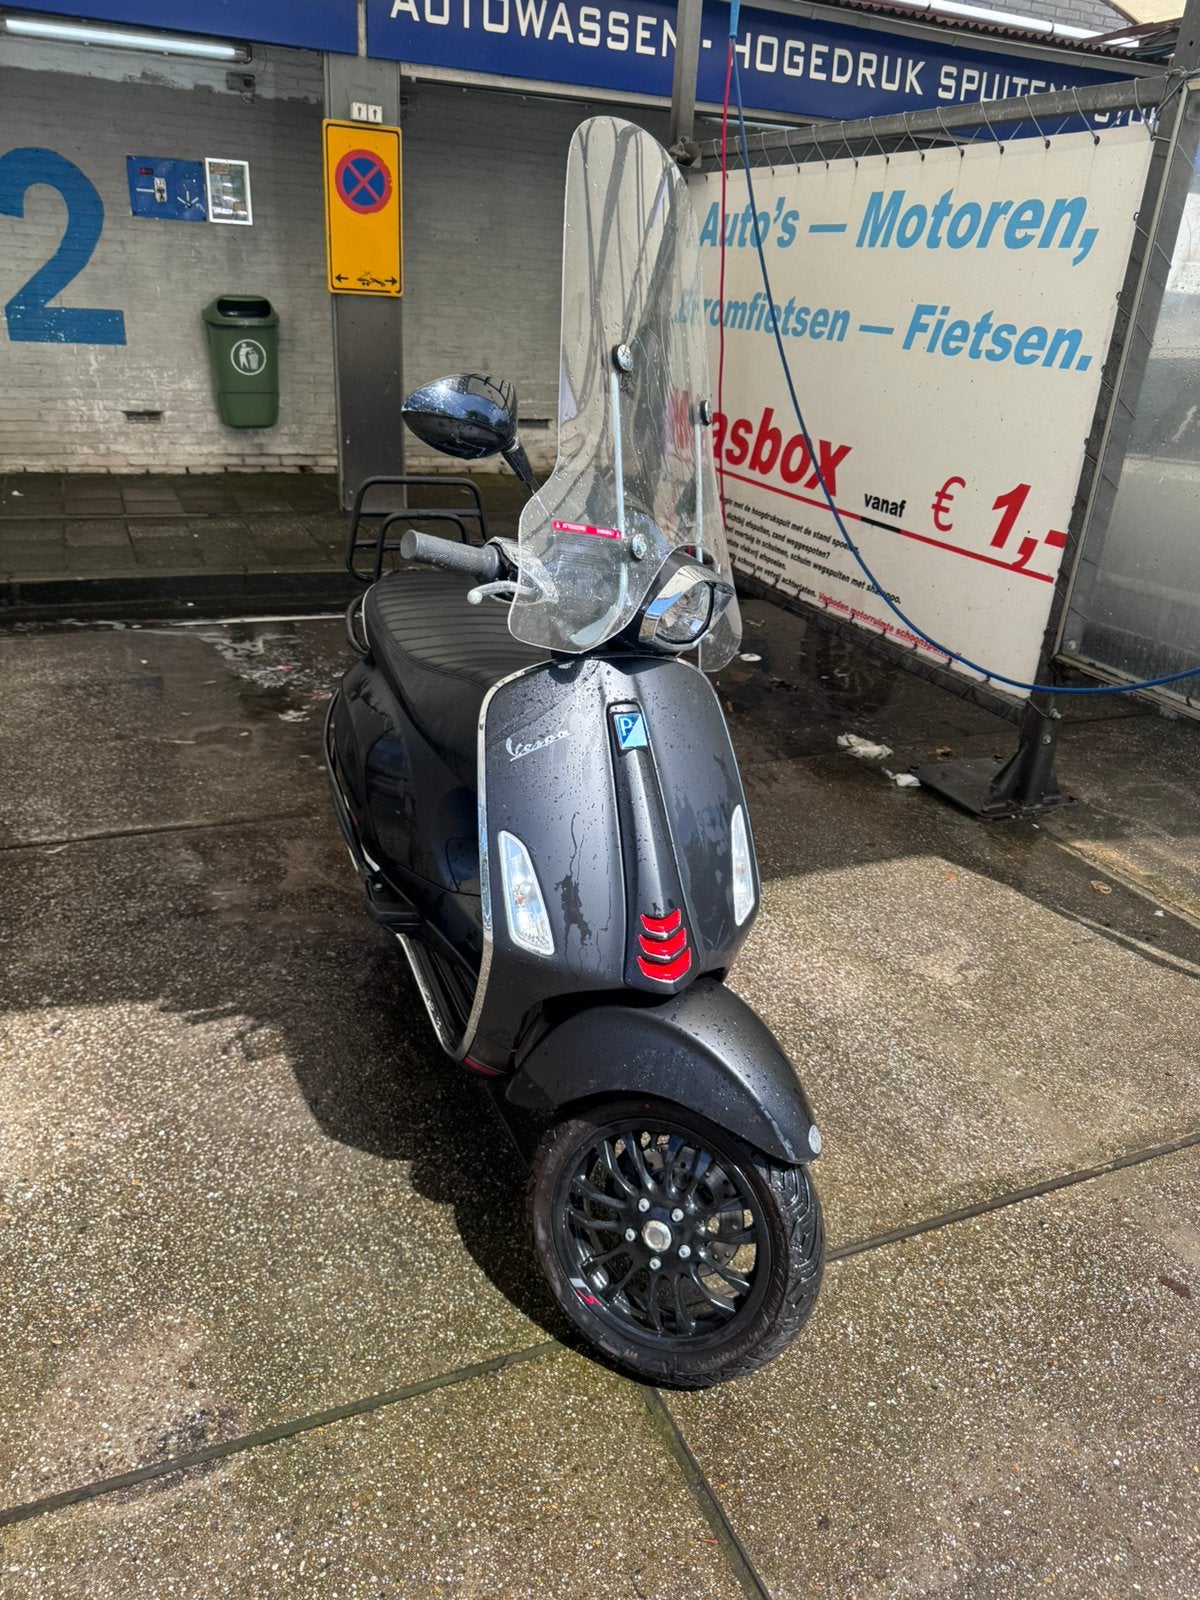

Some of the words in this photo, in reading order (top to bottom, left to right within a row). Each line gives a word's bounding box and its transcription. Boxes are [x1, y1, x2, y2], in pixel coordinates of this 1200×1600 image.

[730, 32, 926, 96] HOGEDRUK
[0, 147, 127, 346] 2
[855, 182, 1099, 267] Motoren,
[902, 303, 1093, 372] Fietsen.
[673, 388, 853, 497] asbox
[864, 493, 907, 518] vanaf
[931, 475, 967, 533] €
[771, 530, 786, 543] zand
[786, 537, 831, 560] weggespoten?
[791, 522, 804, 534] met
[803, 526, 812, 537] de
[812, 529, 832, 544] stand
[812, 561, 851, 584] wegspuiten
[850, 577, 866, 590] met
[505, 729, 574, 762] Vespa
